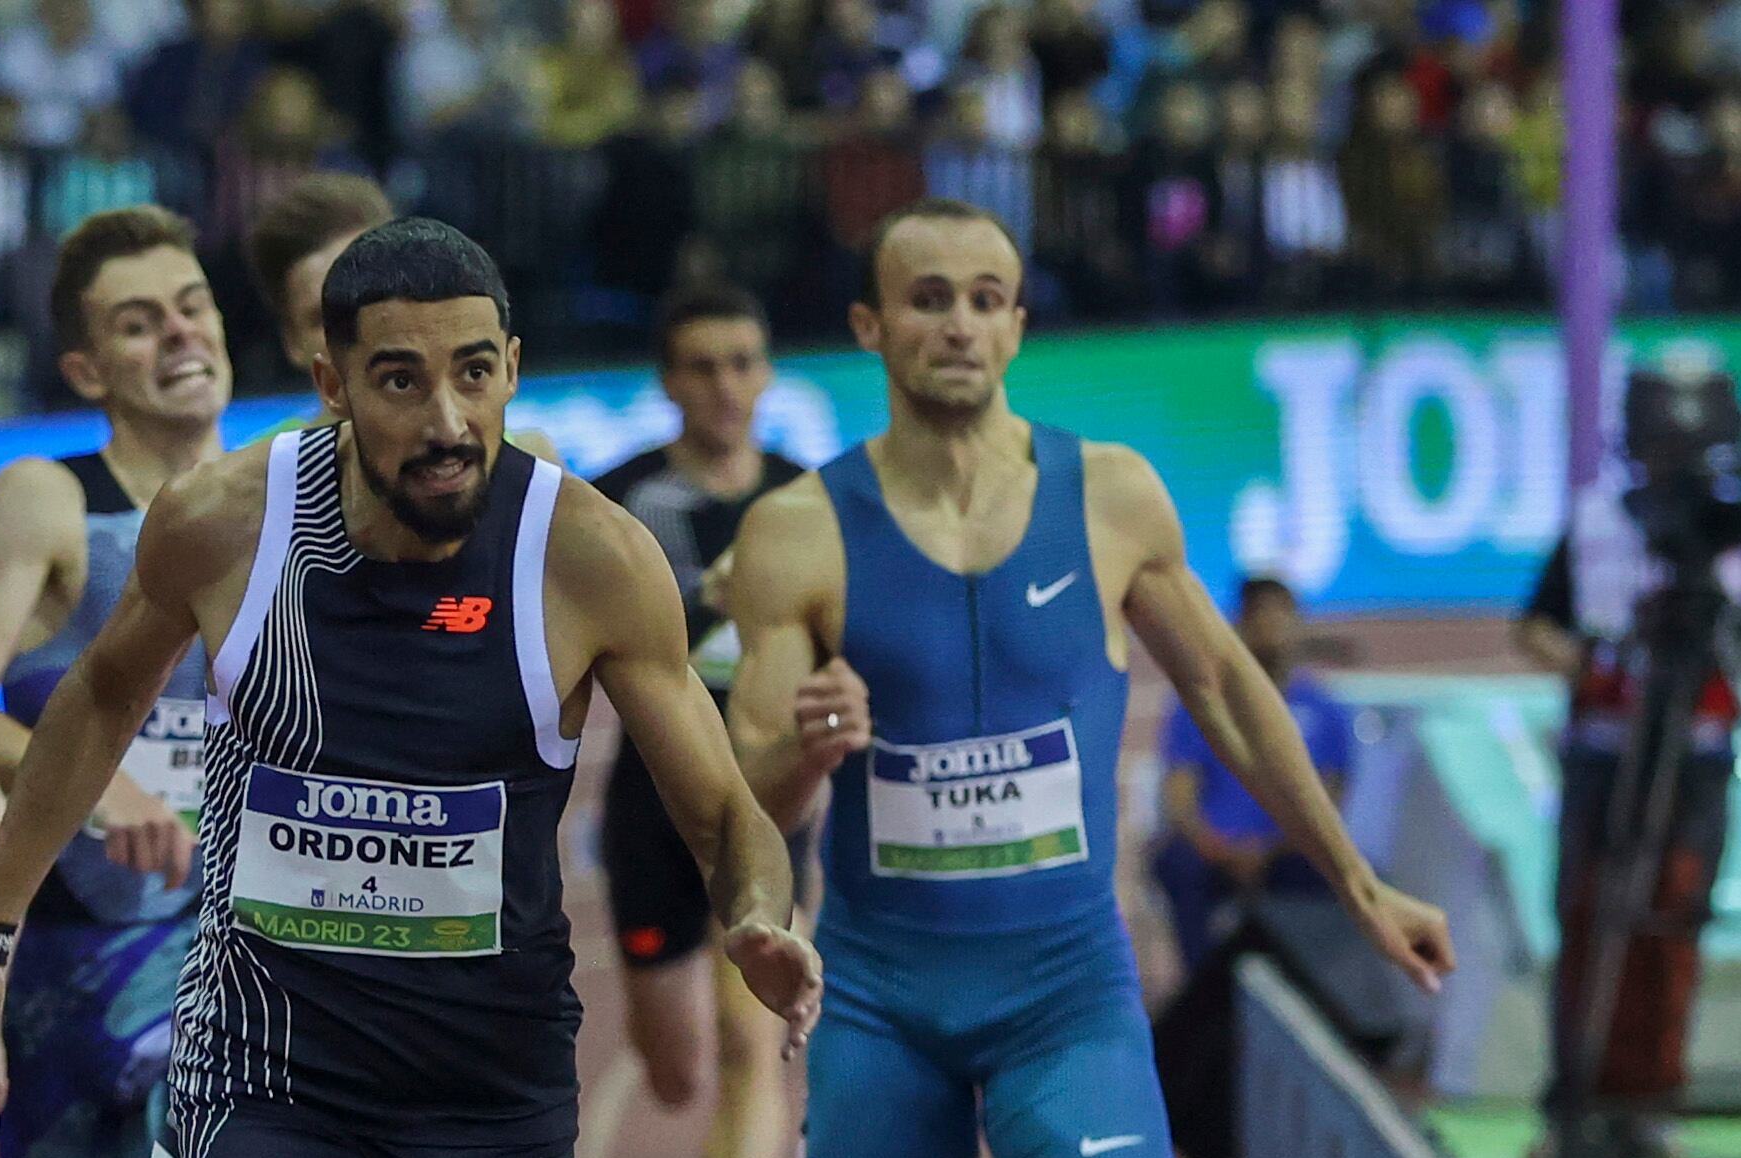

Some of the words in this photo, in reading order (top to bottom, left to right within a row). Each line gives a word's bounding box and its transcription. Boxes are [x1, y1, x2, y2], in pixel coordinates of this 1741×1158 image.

[420, 597, 492, 632] NB
[297, 780, 448, 827] Joma
[927, 781, 1020, 809] TUKA
[361, 876, 377, 893] 4
[339, 892, 424, 912] MADRID
[254, 912, 365, 942] MADRID
[373, 925, 410, 947] 23
